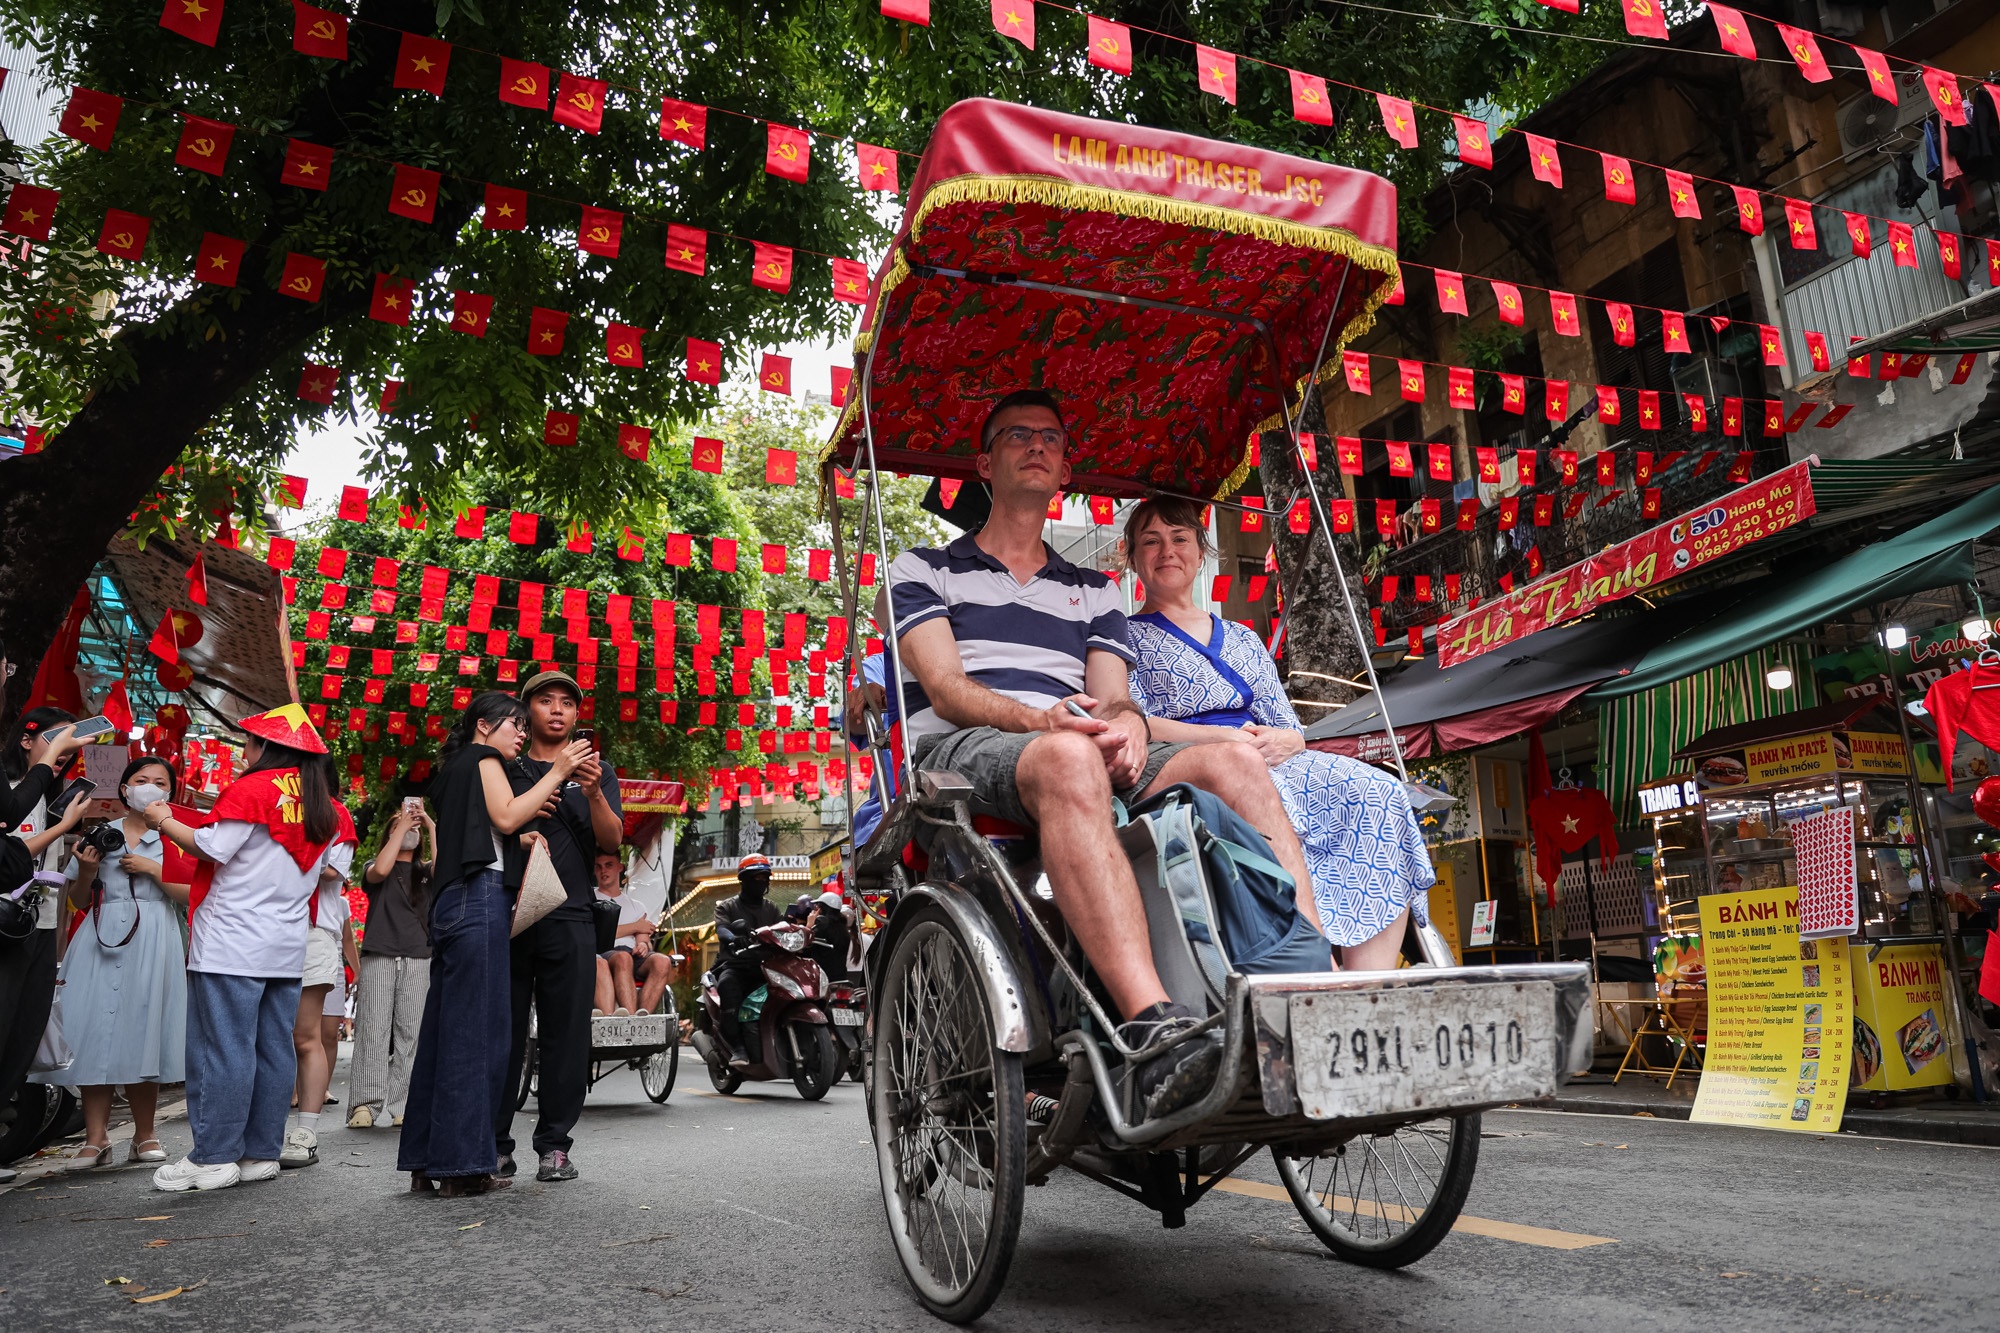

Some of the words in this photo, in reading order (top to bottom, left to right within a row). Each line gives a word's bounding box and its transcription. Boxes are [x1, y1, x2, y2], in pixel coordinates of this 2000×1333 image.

[1906, 86, 1920, 98] LG
[1053, 133, 1107, 170] LAM
[1114, 144, 1168, 178] ANH
[1690, 507, 1726, 536] 50
[1729, 497, 1766, 519] Hàng
[1769, 484, 1792, 502] Mã
[1694, 528, 1729, 550] 0912
[1733, 514, 1761, 532] 430
[1766, 500, 1794, 519] 169
[1696, 542, 1730, 562] 0989
[1736, 530, 1764, 546] 296
[1767, 513, 1797, 532] 972
[1450, 608, 1513, 655] Hà
[1521, 552, 1658, 624] Trang
[1749, 746, 1779, 766] BÁNH
[1782, 742, 1796, 761] MÌ
[1799, 736, 1828, 758] PATÊ
[1852, 736, 1874, 753] BÁNH
[1638, 784, 1681, 814] TRANG
[1719, 899, 1778, 923] BÁNH
[1785, 899, 1800, 918] M
[1709, 930, 1725, 940] Trang
[1742, 928, 1750, 937] 50
[1751, 926, 1766, 936] Hàng
[1767, 925, 1776, 935] Mã
[1879, 953, 1921, 987] BÁNH
[1906, 991, 1931, 1003] TRANG
